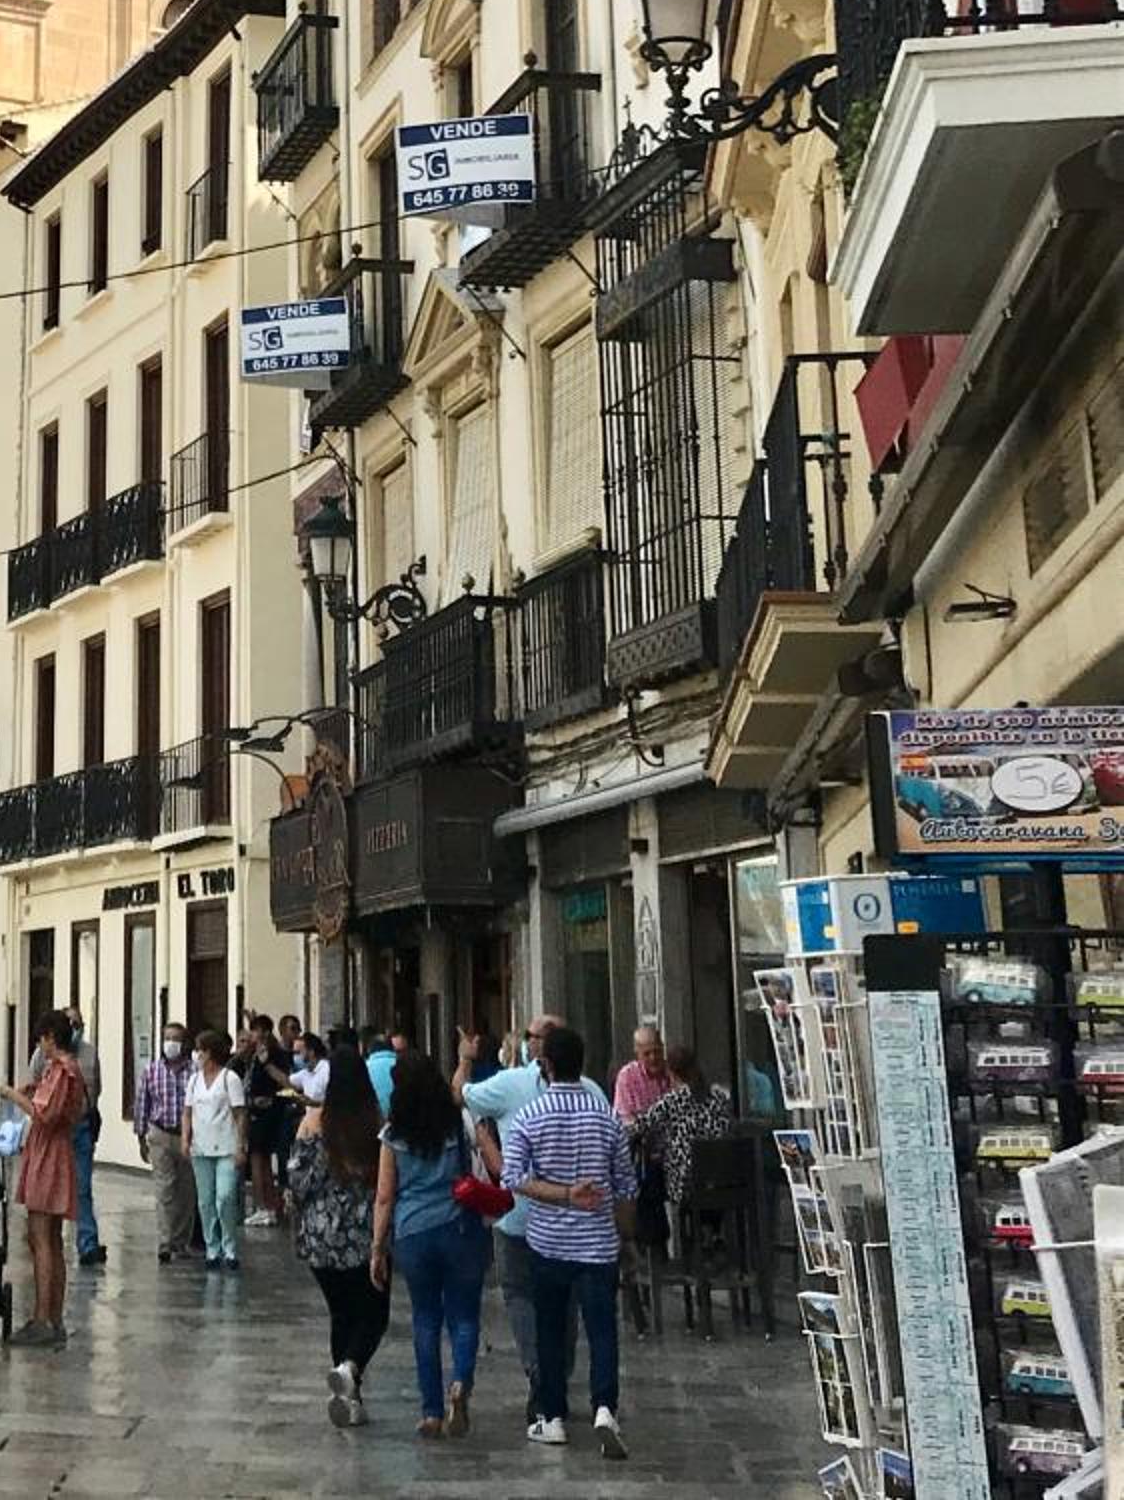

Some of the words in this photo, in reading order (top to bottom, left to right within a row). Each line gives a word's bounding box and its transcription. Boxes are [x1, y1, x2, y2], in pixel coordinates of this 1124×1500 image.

[429, 119, 497, 141] VENDE
[407, 150, 450, 181] SG
[412, 189, 444, 207] 645
[447, 186, 469, 202] 77
[267, 303, 321, 320] VENDE
[248, 327, 284, 352] SG
[252, 357, 279, 372] 645
[281, 354, 299, 368] 77
[321, 351, 339, 365] 39
[961, 714, 989, 729] de
[992, 713, 1034, 729] 500
[898, 730, 1024, 747] disponibles
[1029, 731, 1056, 743] en
[921, 816, 1085, 842] Autocaravana
